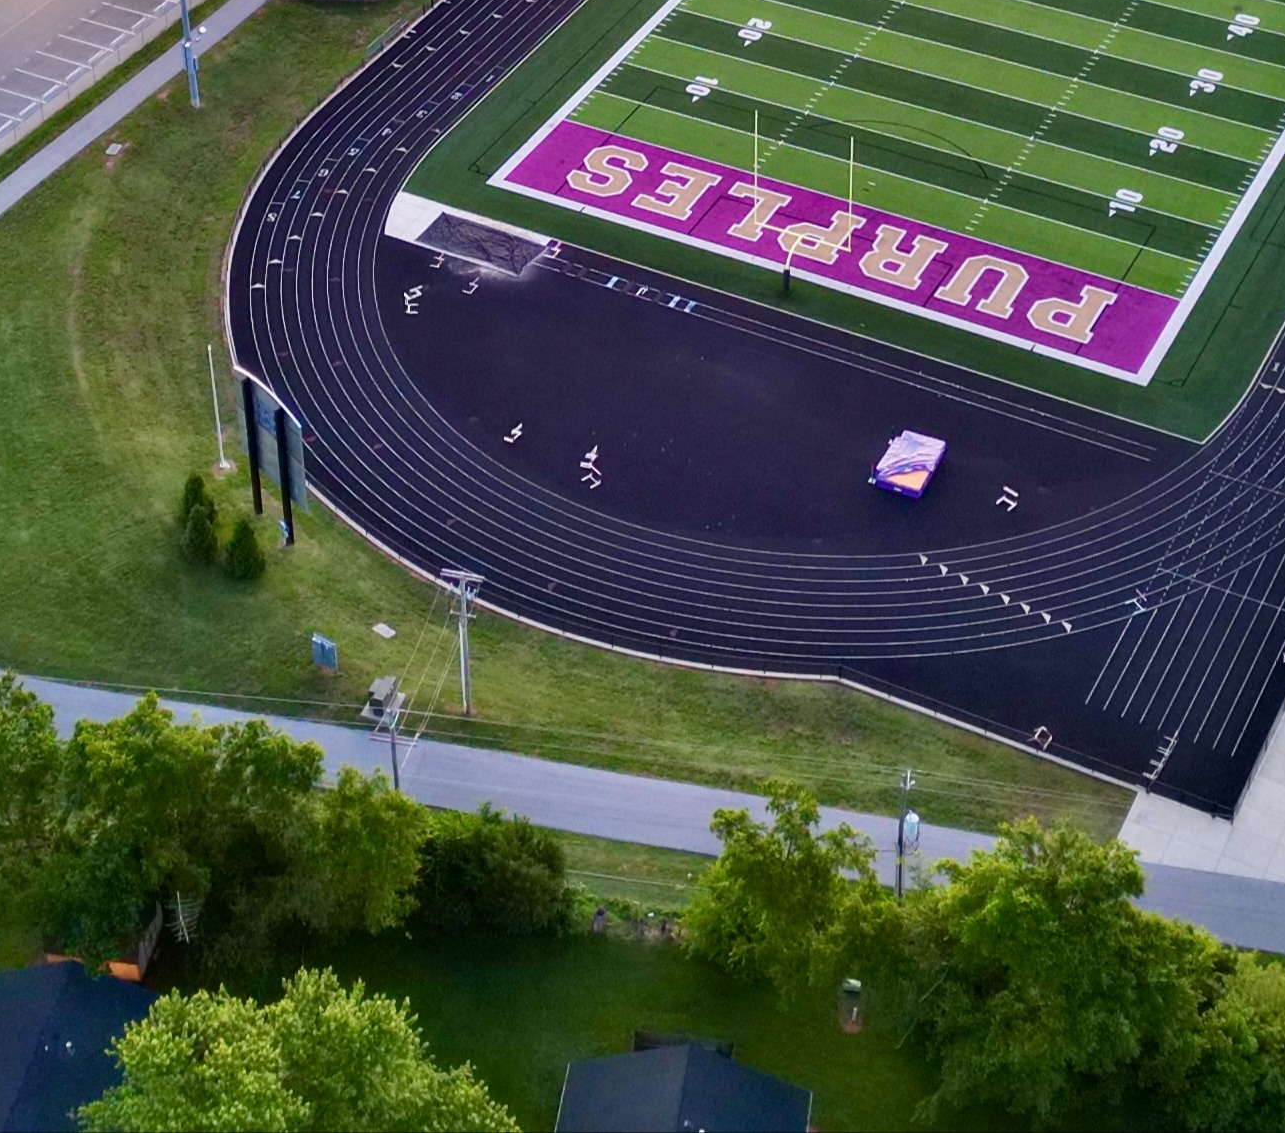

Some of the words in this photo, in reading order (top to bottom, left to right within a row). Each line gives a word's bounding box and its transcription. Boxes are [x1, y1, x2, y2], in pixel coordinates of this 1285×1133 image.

[738, 17, 772, 41] 20
[1228, 13, 1260, 36] 40
[686, 76, 718, 97] 10
[1189, 68, 1224, 93] 30
[1149, 126, 1185, 154] 20
[1109, 188, 1144, 213] 10
[566, 144, 1118, 344] PURPLES
[1272, 362, 1280, 372] 1
